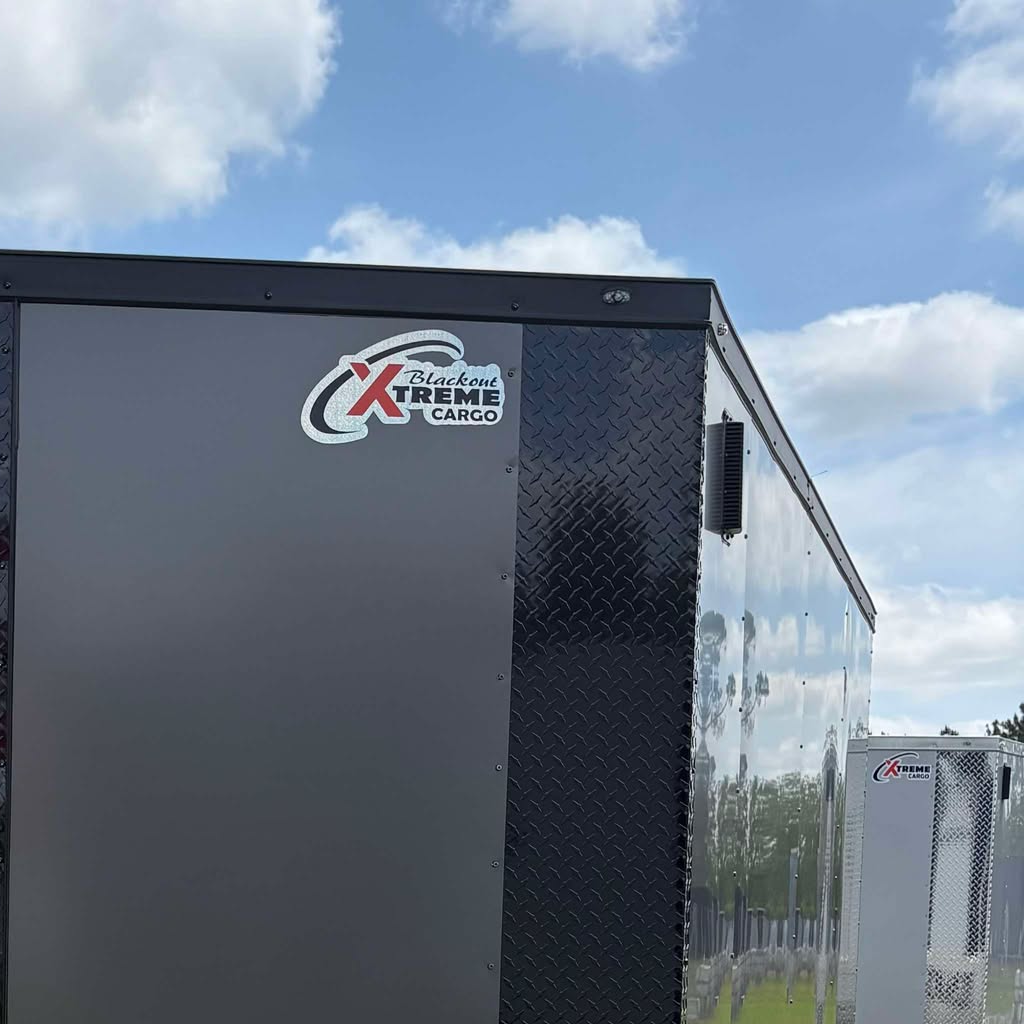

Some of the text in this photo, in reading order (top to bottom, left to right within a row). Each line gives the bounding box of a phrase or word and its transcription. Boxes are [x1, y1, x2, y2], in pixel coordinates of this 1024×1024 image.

[404, 369, 498, 388] Blackout
[346, 362, 501, 418] XTREME
[431, 407, 498, 423] CARGO
[883, 759, 931, 777] XTREME
